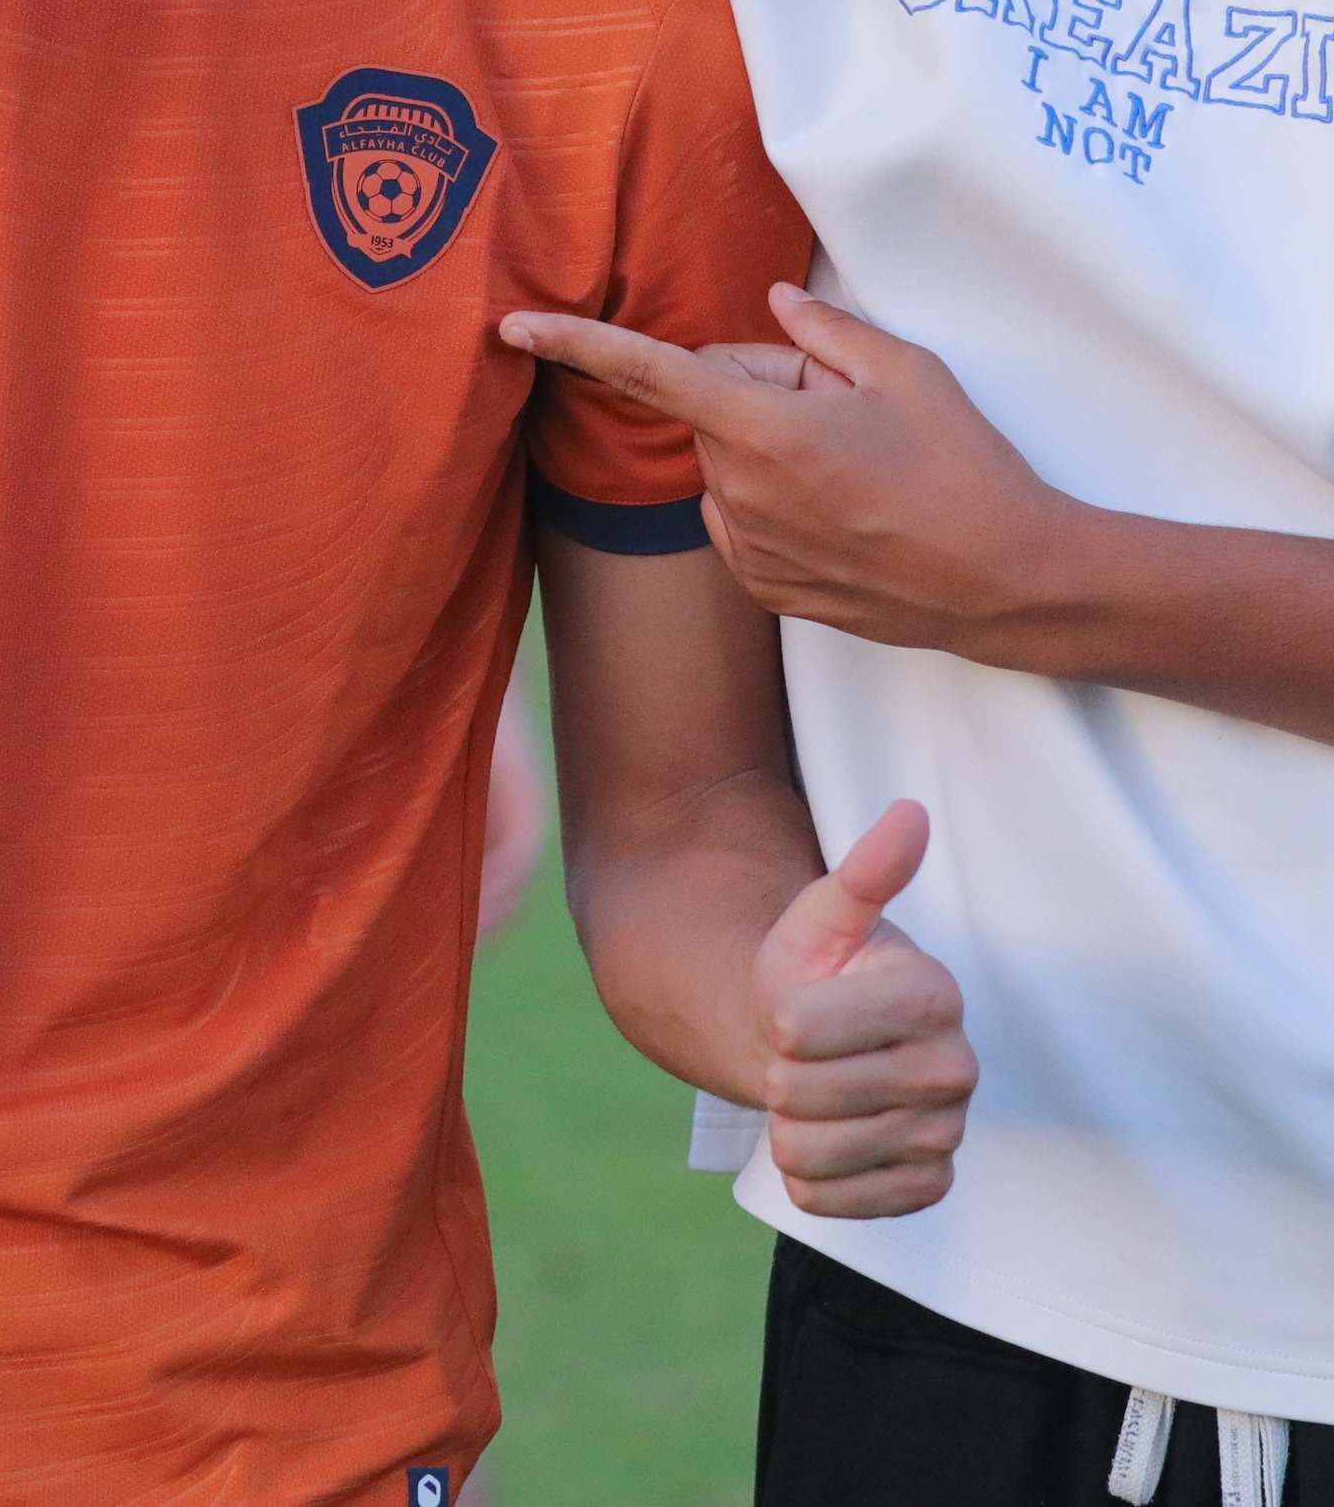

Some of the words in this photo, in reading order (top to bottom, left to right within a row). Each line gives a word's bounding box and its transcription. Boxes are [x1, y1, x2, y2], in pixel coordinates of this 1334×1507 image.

[1021, 45, 1050, 93] I
[1080, 77, 1175, 149] AM
[341, 139, 405, 153] ALFAYHA
[411, 145, 446, 168] CLUB
[1036, 102, 1152, 186] NOT
[370, 235, 394, 249] 1953
